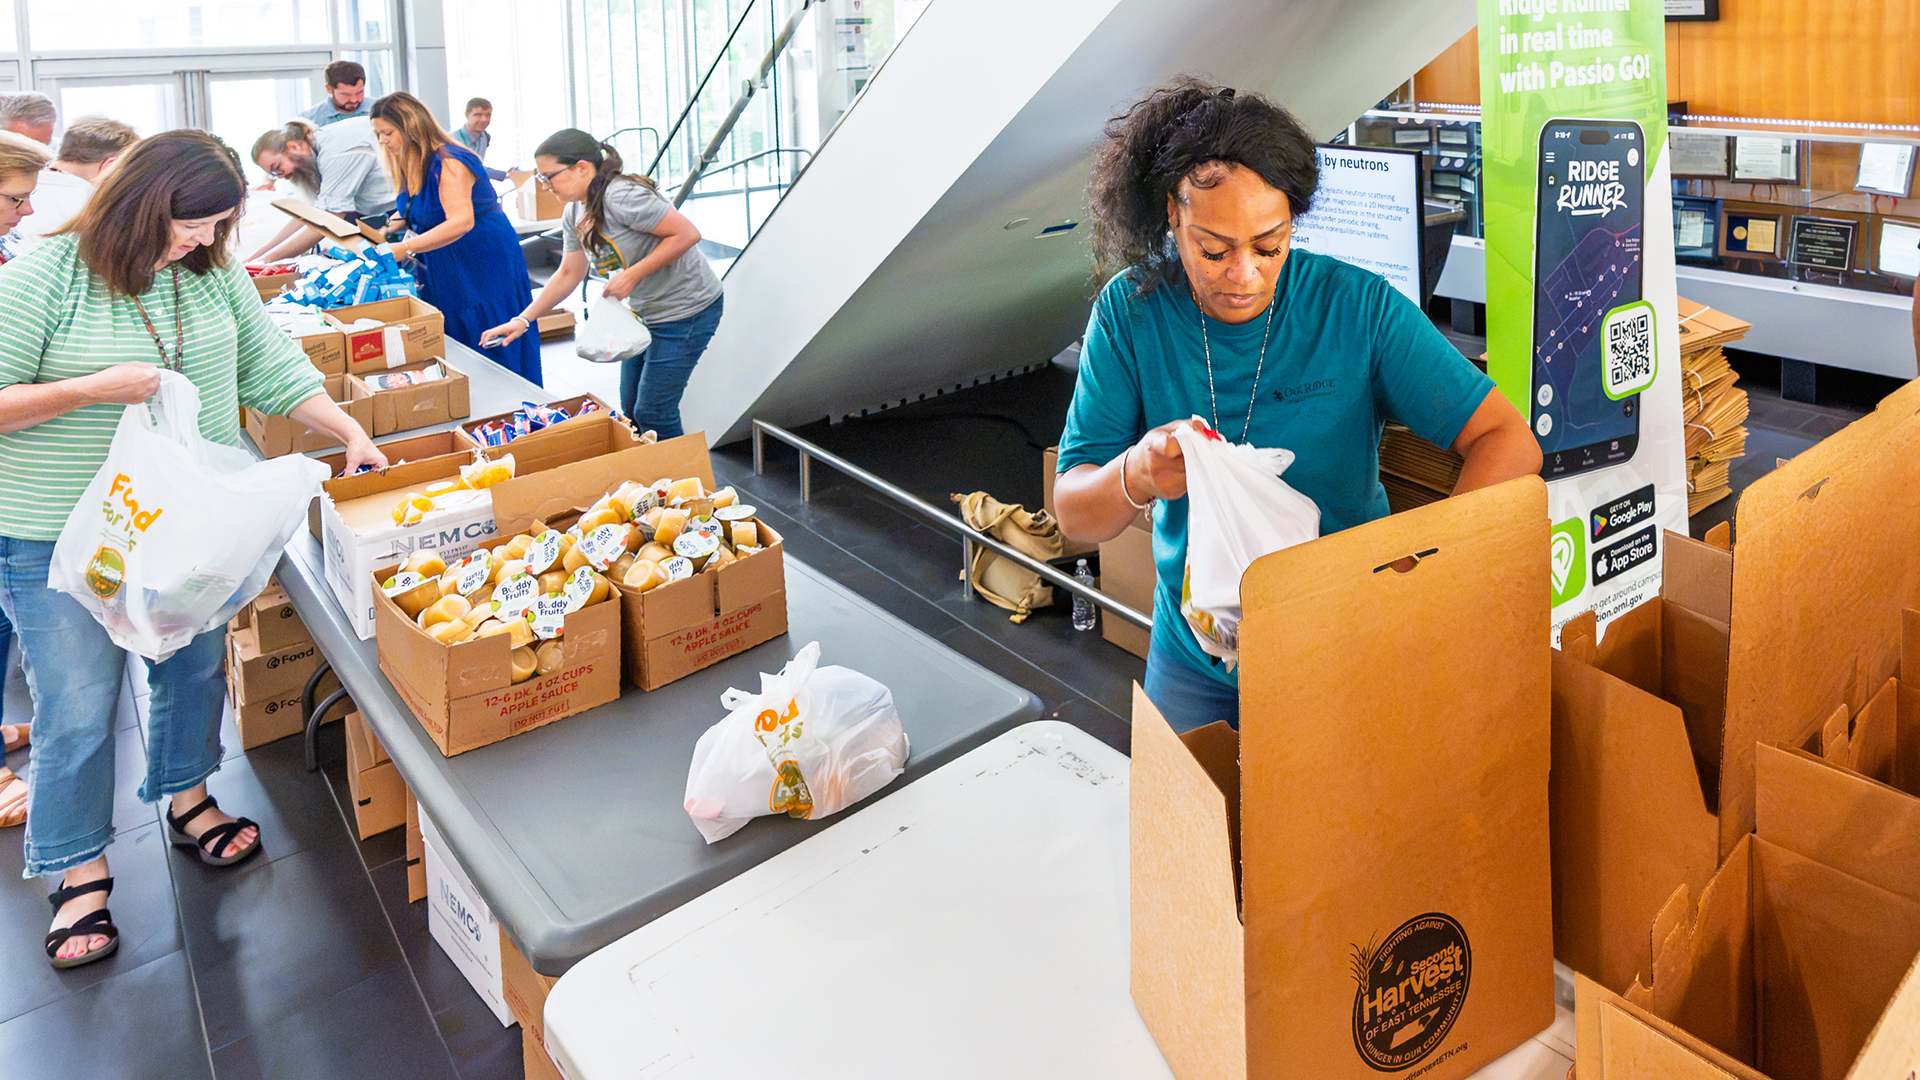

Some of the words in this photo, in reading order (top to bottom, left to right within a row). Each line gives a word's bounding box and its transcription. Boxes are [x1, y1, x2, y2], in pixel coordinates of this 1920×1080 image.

[1500, 26, 1518, 54] in
[1522, 22, 1563, 53] real
[1567, 21, 1613, 50] time
[1500, 61, 1545, 94] with
[1549, 56, 1615, 88] Passio
[1618, 53, 1651, 82] GO!
[1324, 153, 1337, 170] by
[1340, 157, 1390, 172] neutrons
[1568, 160, 1620, 182] RIDGE
[1345, 189, 1367, 198] neutron
[1367, 191, 1396, 202] scattering
[1377, 203, 1410, 215] Heisenberg
[1556, 181, 1628, 212] RUNNER
[1366, 210, 1375, 219] the
[1376, 211, 1402, 222] structure
[1609, 502, 1619, 514] GET
[1624, 499, 1631, 508] ON
[1609, 506, 1637, 527] Google
[1637, 500, 1653, 514] Play
[1610, 539, 1634, 557] Download
[1635, 538, 1641, 546] on
[1641, 533, 1650, 543] the
[1610, 553, 1629, 572] App
[1630, 542, 1653, 562] Store
[501, 579, 532, 596] Buddy
[505, 588, 530, 601] Fruits
[1590, 602, 1598, 611] to
[1599, 595, 1612, 611] get
[1612, 583, 1637, 601] around
[537, 599, 568, 610] Buddy
[539, 607, 565, 616] Fruits
[684, 633, 717, 654] APPLE
[719, 619, 751, 640] SAUCE
[281, 646, 315, 665] Food
[483, 692, 511, 708] 12-6
[535, 681, 543, 691] 4
[562, 664, 594, 681] CUPS
[500, 696, 539, 717] APPLE
[541, 680, 579, 703] SAUCE
[1379, 926, 1413, 962] FIGHTING
[1414, 920, 1445, 932] AGAINST
[1410, 941, 1455, 975] Second
[1363, 945, 1464, 1024] Harvest
[1366, 1026, 1380, 1041] OF
[1381, 1013, 1406, 1032] EAST
[1408, 980, 1462, 1017] TENNESSEE
[1366, 1042, 1393, 1063] HUNGER
[1393, 1052, 1402, 1064] IN
[1404, 1046, 1422, 1062] OUR
[1423, 990, 1462, 1050] COMMUNITY
